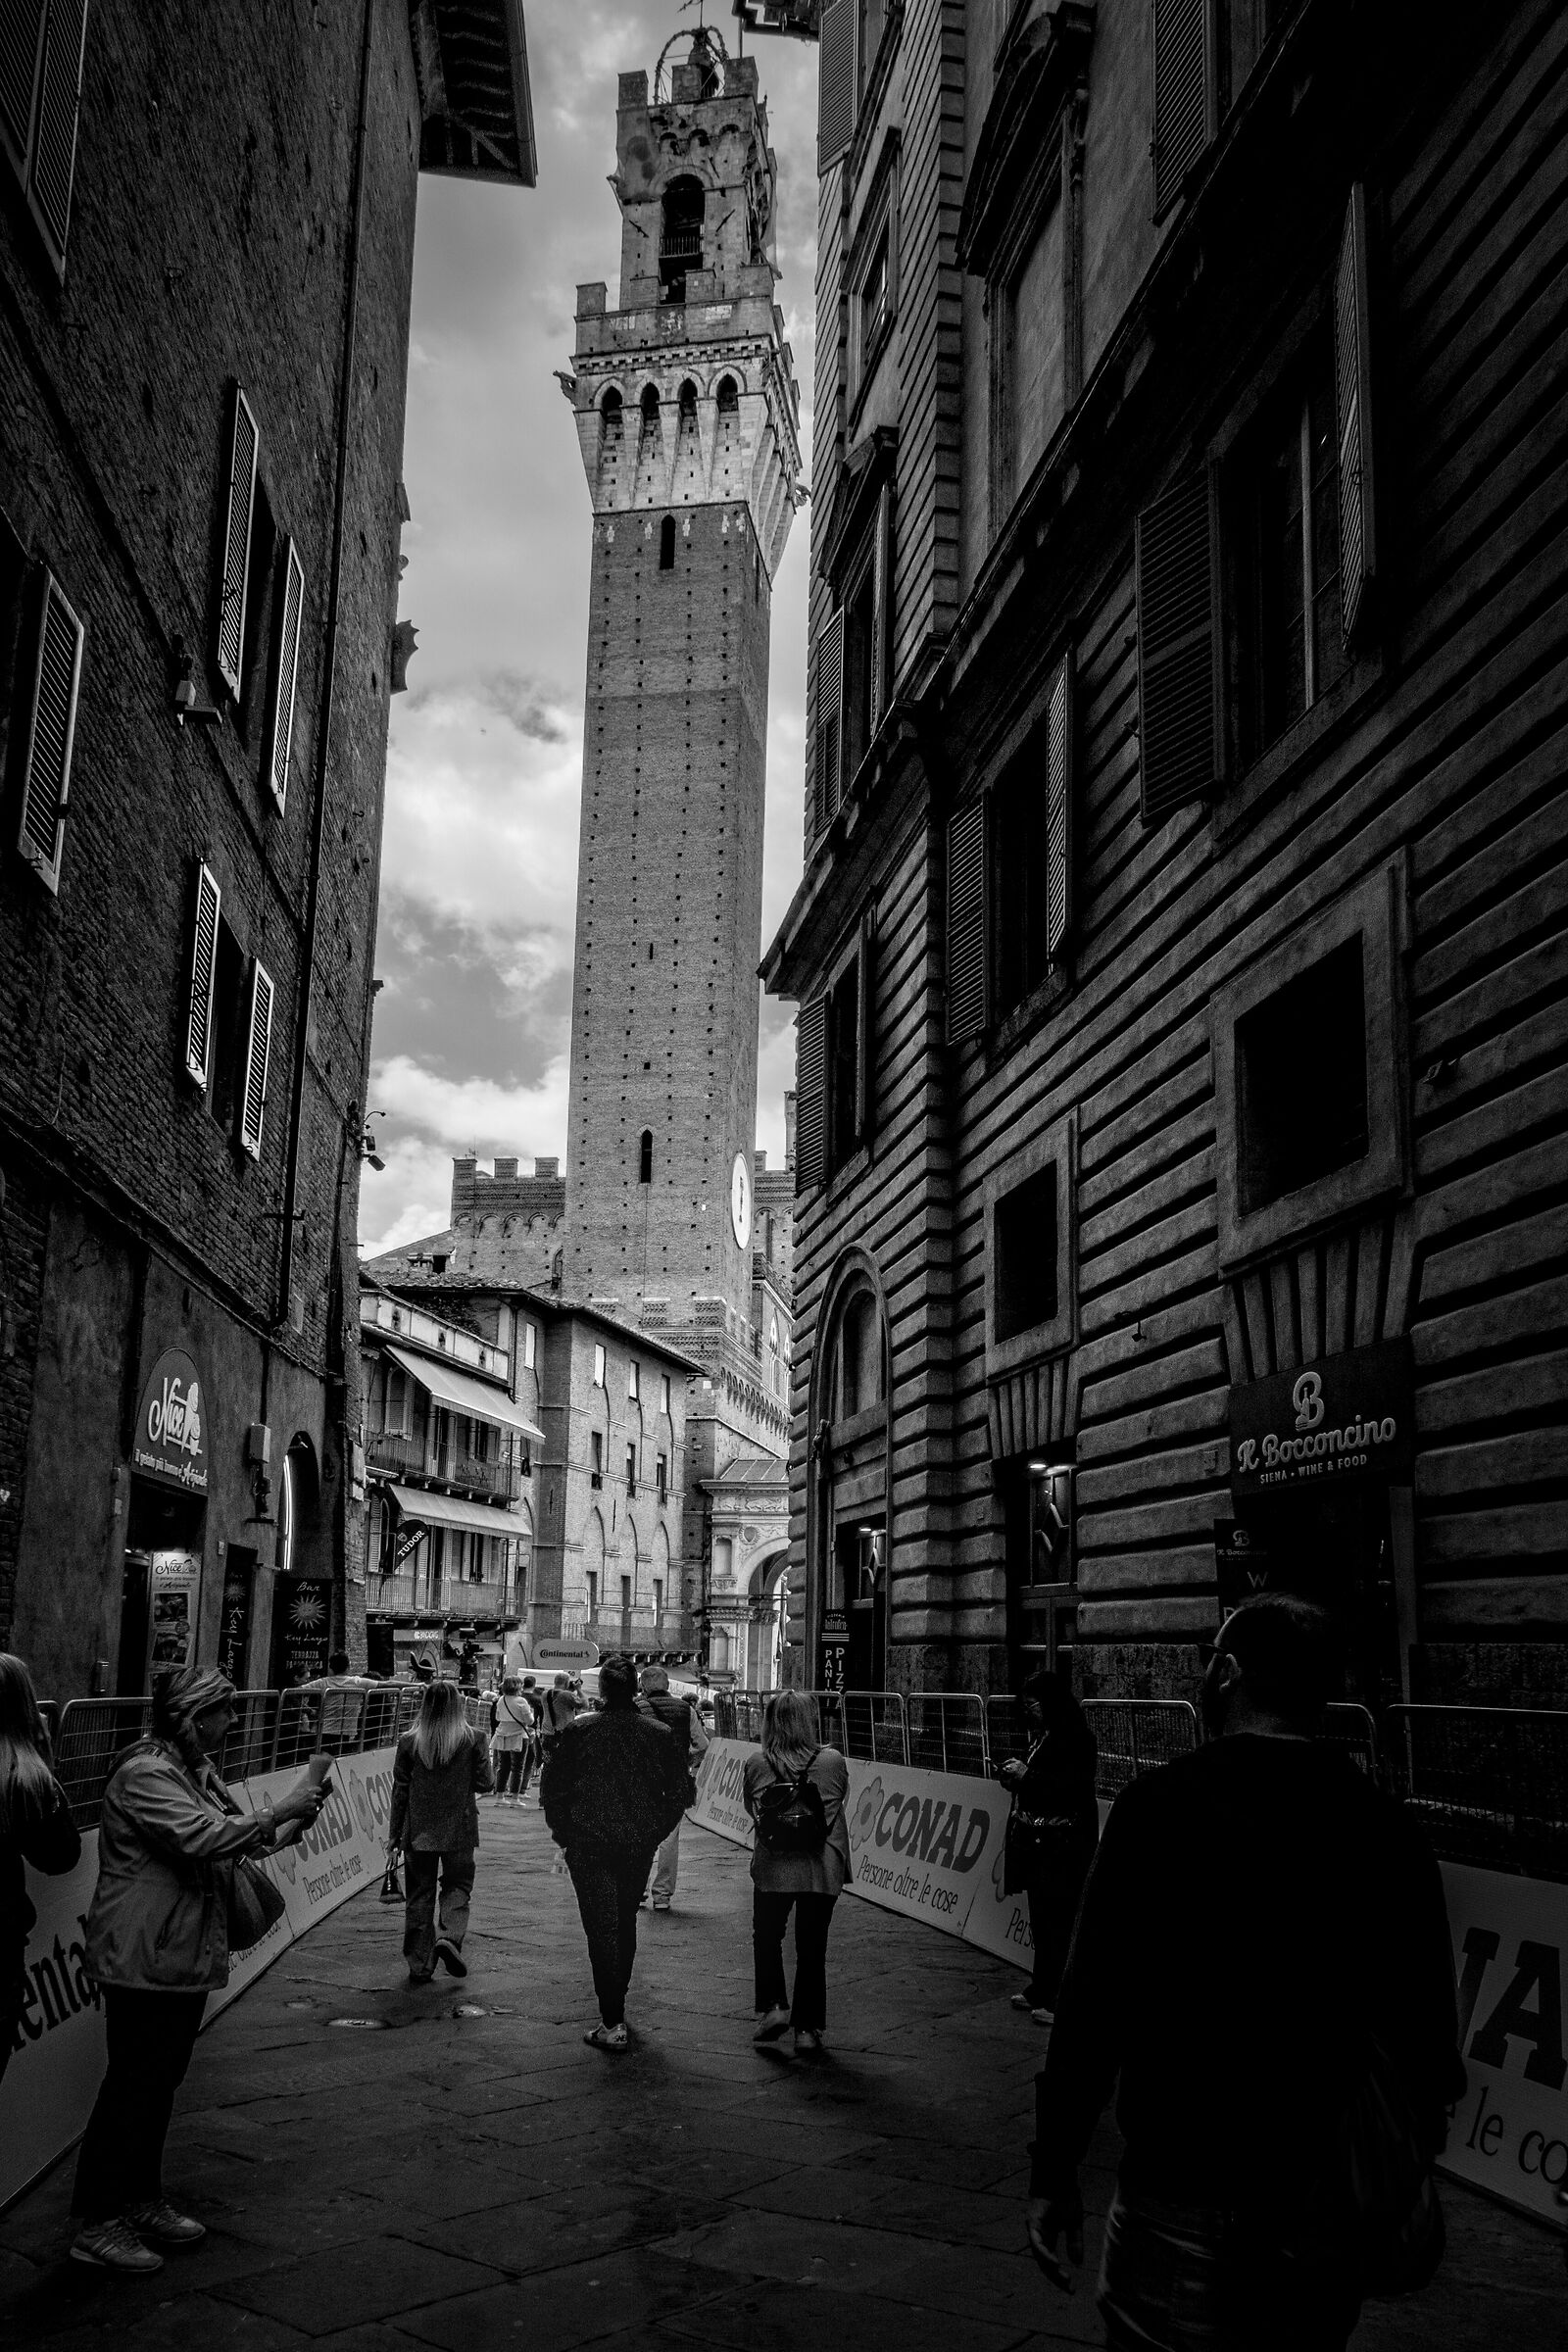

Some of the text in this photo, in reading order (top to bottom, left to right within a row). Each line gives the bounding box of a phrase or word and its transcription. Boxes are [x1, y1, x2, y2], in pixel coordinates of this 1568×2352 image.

[147, 1377, 186, 1446] Nice
[1262, 1414, 1396, 1468] Bocconcino
[1260, 1470, 1288, 1485] SIENA
[1298, 1463, 1323, 1478] WINE
[1338, 1454, 1367, 1470] FOOD
[397, 1530, 425, 1556] TUDOR
[156, 1559, 182, 1575] Nice
[296, 1581, 321, 1592] Bar
[220, 1606, 245, 1633] Key
[284, 1633, 328, 1645] Key Largo
[540, 1649, 583, 1658] Continental
[219, 1638, 243, 1679] Largo
[875, 1792, 991, 1874] CONAD
[303, 1873, 332, 1905] Persone
[349, 1854, 363, 1876] cose
[857, 1854, 957, 1914] Persone oltre le cose
[1466, 2085, 1503, 2156] le
